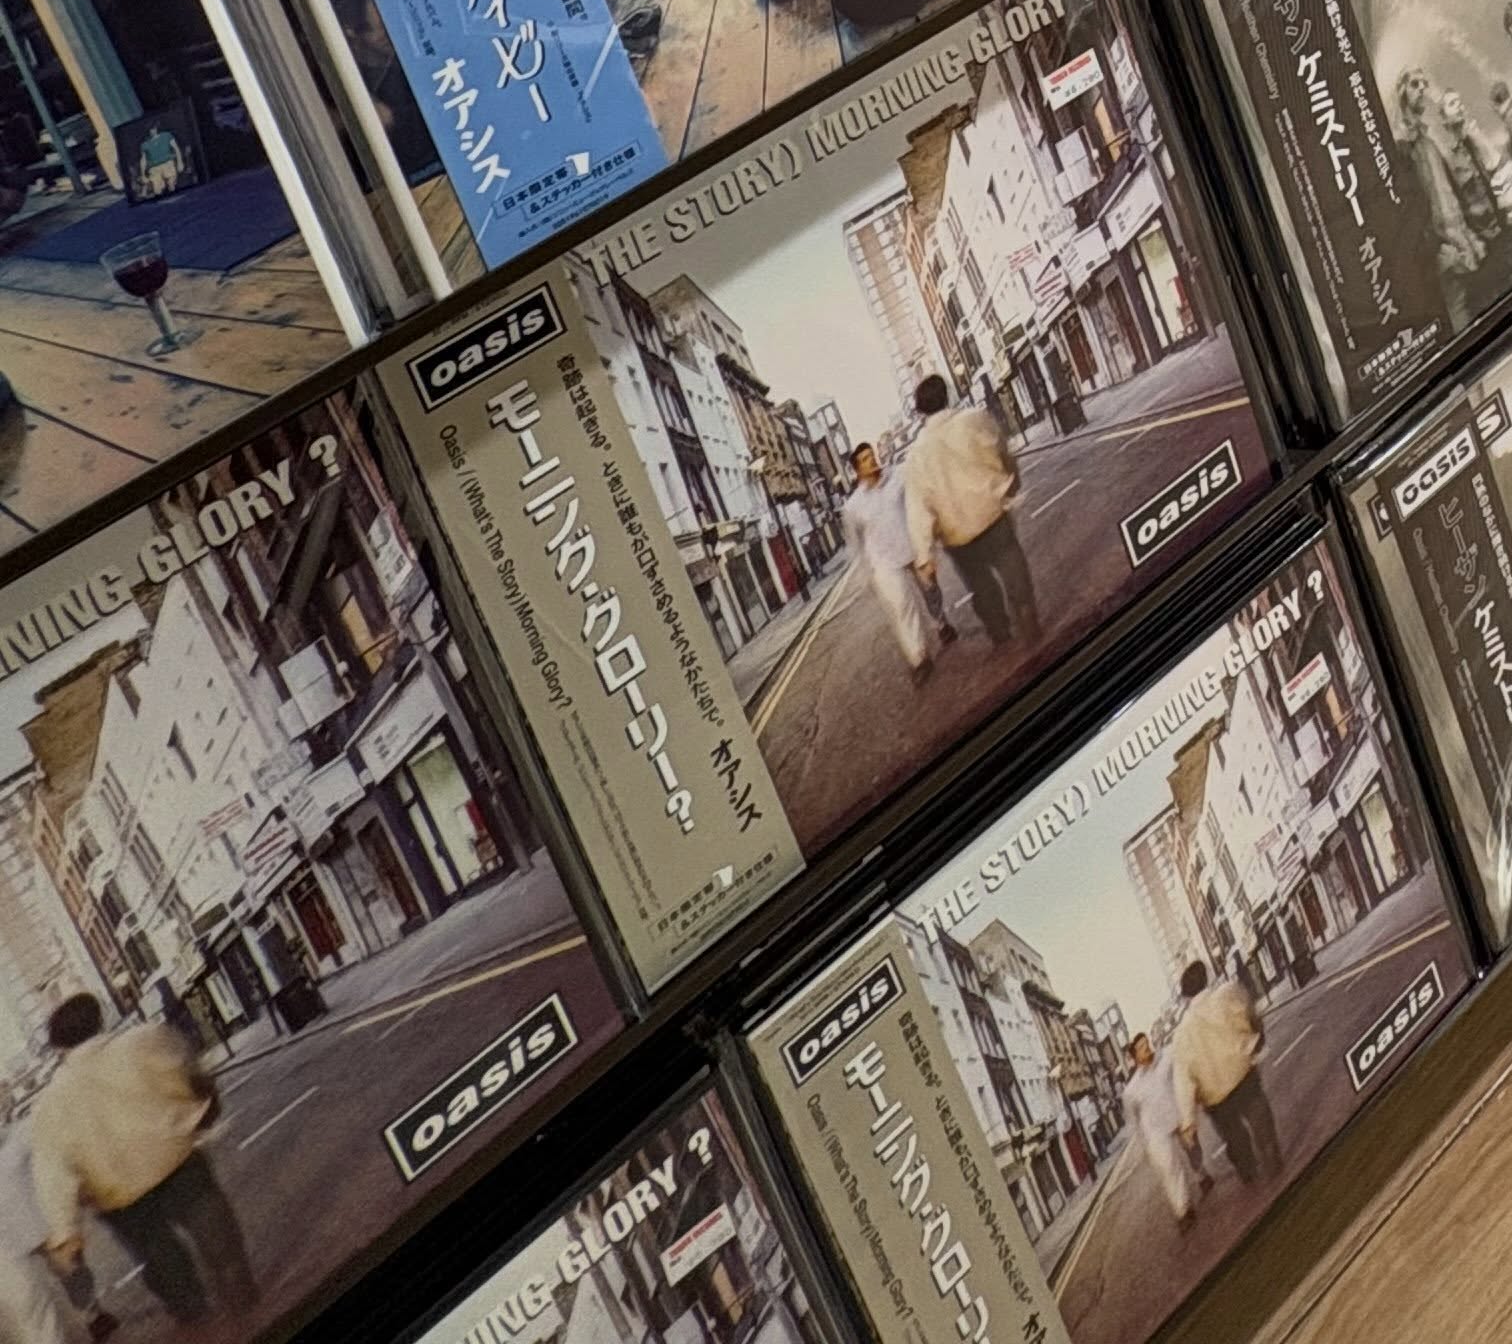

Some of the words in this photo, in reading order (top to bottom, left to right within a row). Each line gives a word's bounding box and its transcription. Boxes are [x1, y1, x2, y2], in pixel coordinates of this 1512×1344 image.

[431, 56, 511, 194] オアシス
[587, 222, 662, 290] THE
[665, 144, 801, 243] STORY)
[808, 46, 968, 164] MORNING
[1358, 235, 1399, 326] オアシス
[430, 307, 546, 388] oasis
[439, 423, 467, 470] Oasis
[1401, 436, 1470, 506] oasis
[138, 458, 296, 585] GLORY
[461, 476, 498, 536] (What's
[491, 533, 509, 561] The
[1134, 454, 1230, 551] oasis
[497, 557, 525, 606] Story)
[514, 602, 551, 666] Morning
[541, 660, 574, 712] Glory?
[709, 737, 763, 834] オアシス
[917, 875, 982, 942] THE
[980, 782, 1091, 898] STORY)
[1093, 664, 1222, 798] MORNING
[1221, 594, 1303, 676] GLORY
[799, 976, 891, 1066] oasis
[1358, 980, 1434, 1072] oasis
[411, 1016, 557, 1154] oasis
[557, 1154, 678, 1286] GLORY
